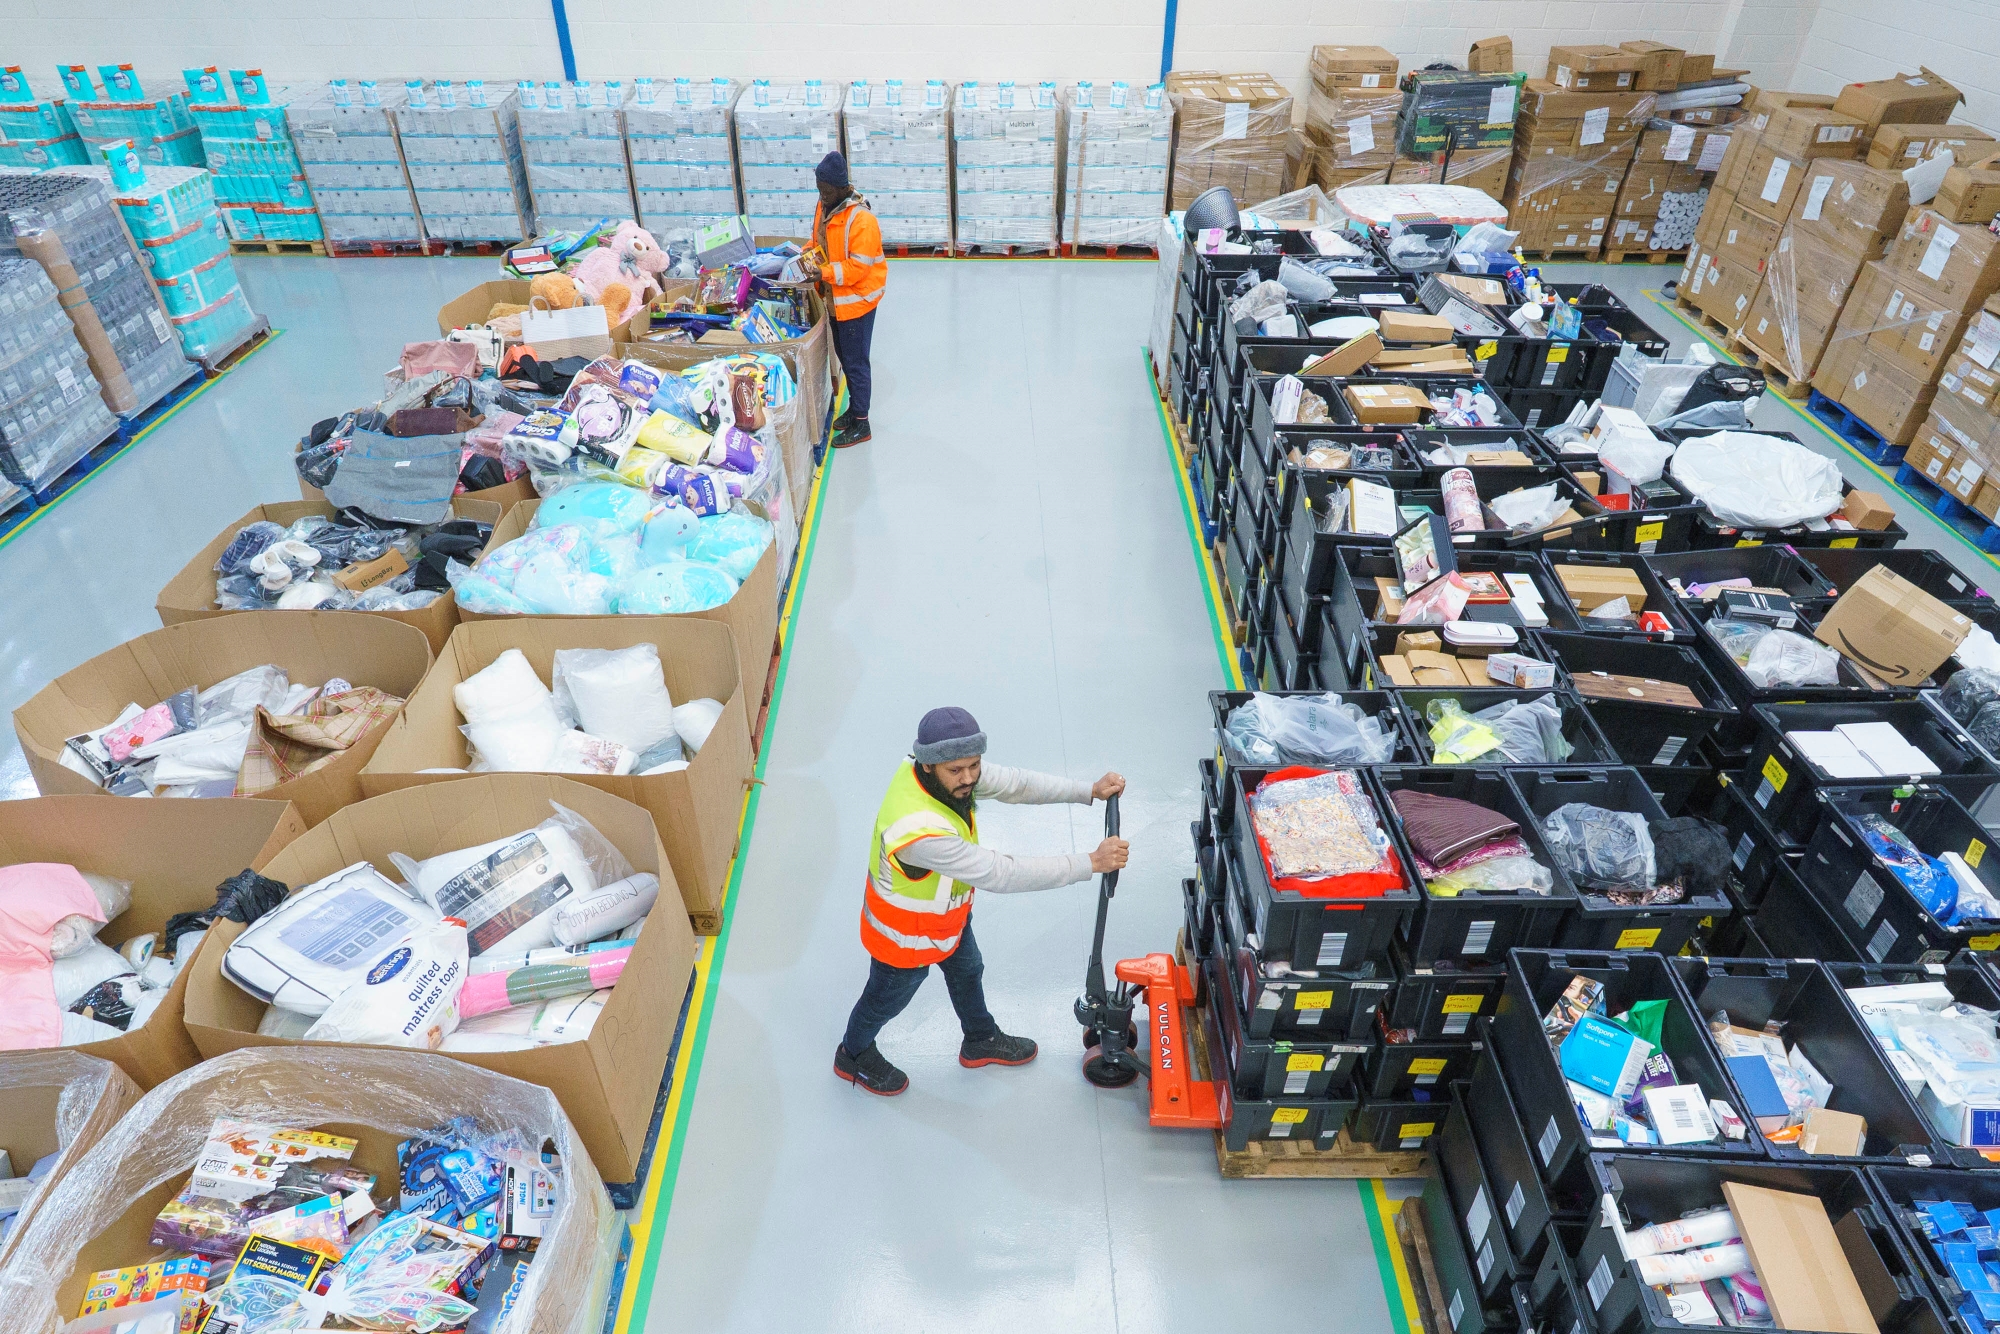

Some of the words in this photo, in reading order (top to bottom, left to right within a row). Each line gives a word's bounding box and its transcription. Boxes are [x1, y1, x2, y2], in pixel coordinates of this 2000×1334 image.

[1009, 120, 1036, 128] Multibank
[630, 365, 655, 381] Andrex
[702, 479, 714, 507] Andrex
[367, 565, 393, 584] LongBay
[435, 861, 488, 900] MICROFIBRE
[440, 889, 466, 911] Mattress
[464, 871, 491, 891] Topper
[569, 908, 598, 928] UTOPIA
[599, 888, 630, 913] BEDDING
[402, 958, 423, 983] essentials
[408, 960, 441, 1003] quilted
[402, 986, 443, 1037] mattress
[1158, 1002, 1172, 1069] VULCAN
[1646, 1058, 1658, 1078] RELIEF
[1654, 1053, 1669, 1074] DEEP
[242, 1257, 254, 1266] KIT
[253, 1261, 278, 1273] SCIENCE
[276, 1267, 307, 1282] MAGIQUE
[87, 1284, 118, 1300] DOUGH
